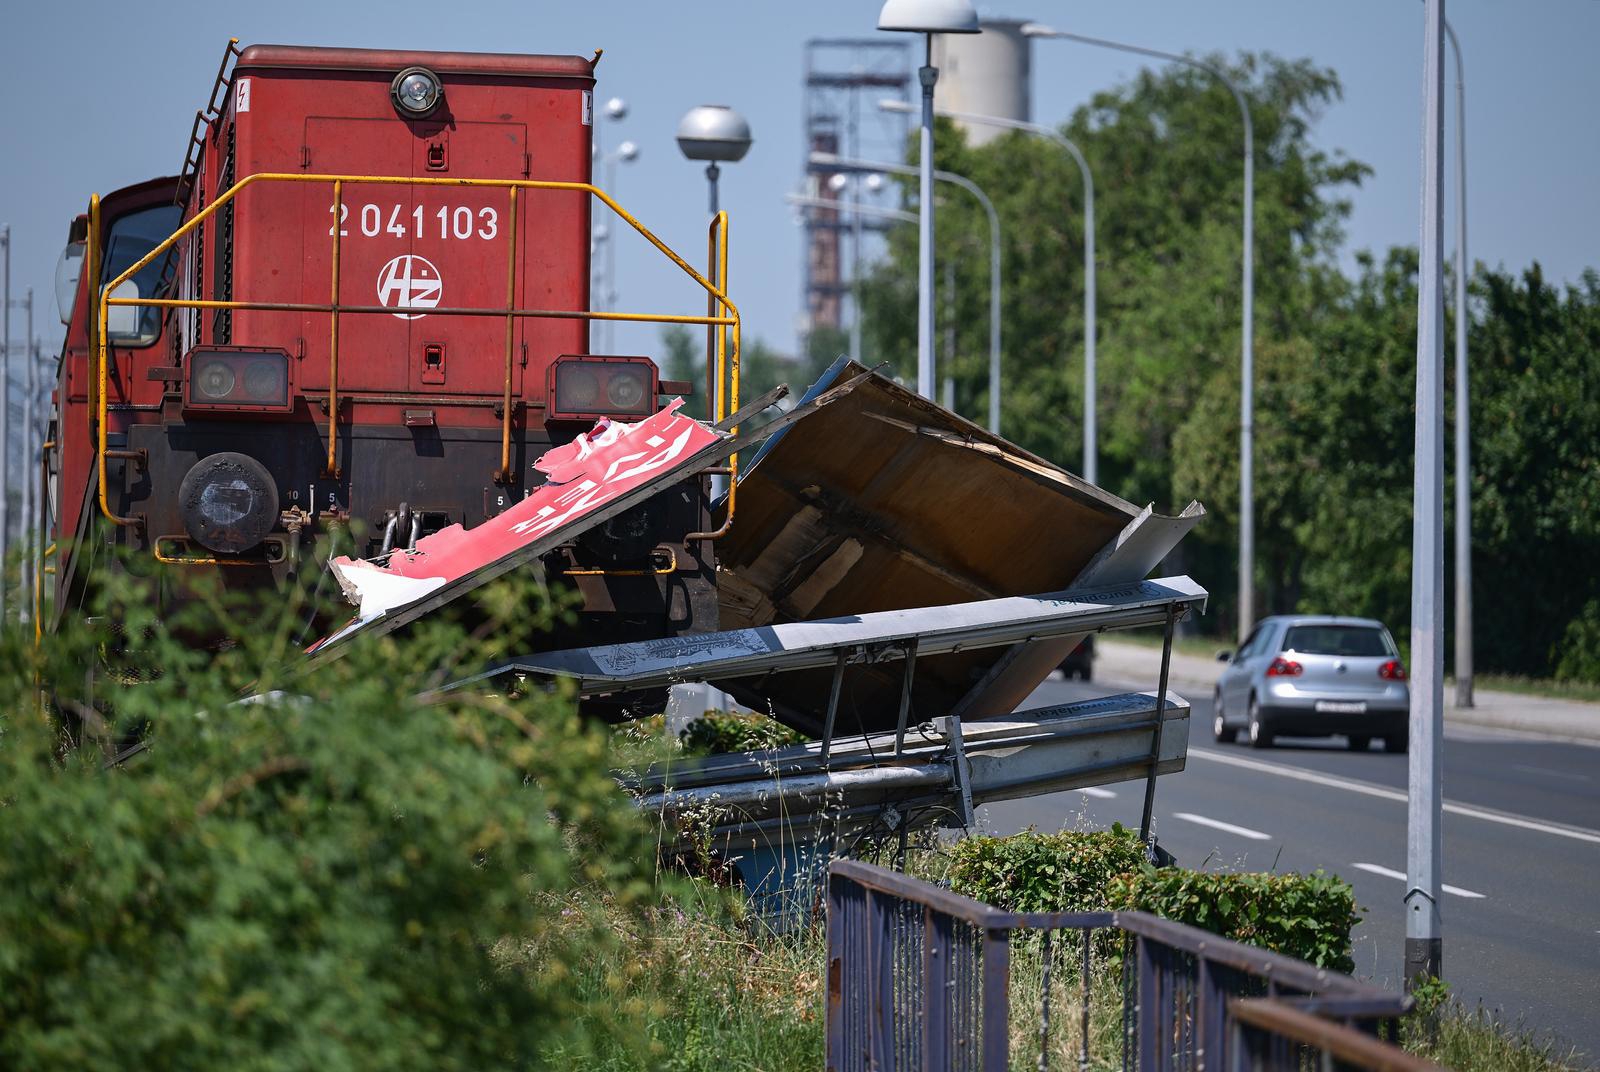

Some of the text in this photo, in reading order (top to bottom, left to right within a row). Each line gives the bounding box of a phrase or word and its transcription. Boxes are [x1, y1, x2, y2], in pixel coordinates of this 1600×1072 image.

[329, 203, 349, 236] 2
[287, 490, 299, 500] 10
[328, 492, 336, 503] 5
[497, 496, 504, 506] 5
[1051, 589, 1134, 608] europlakat
